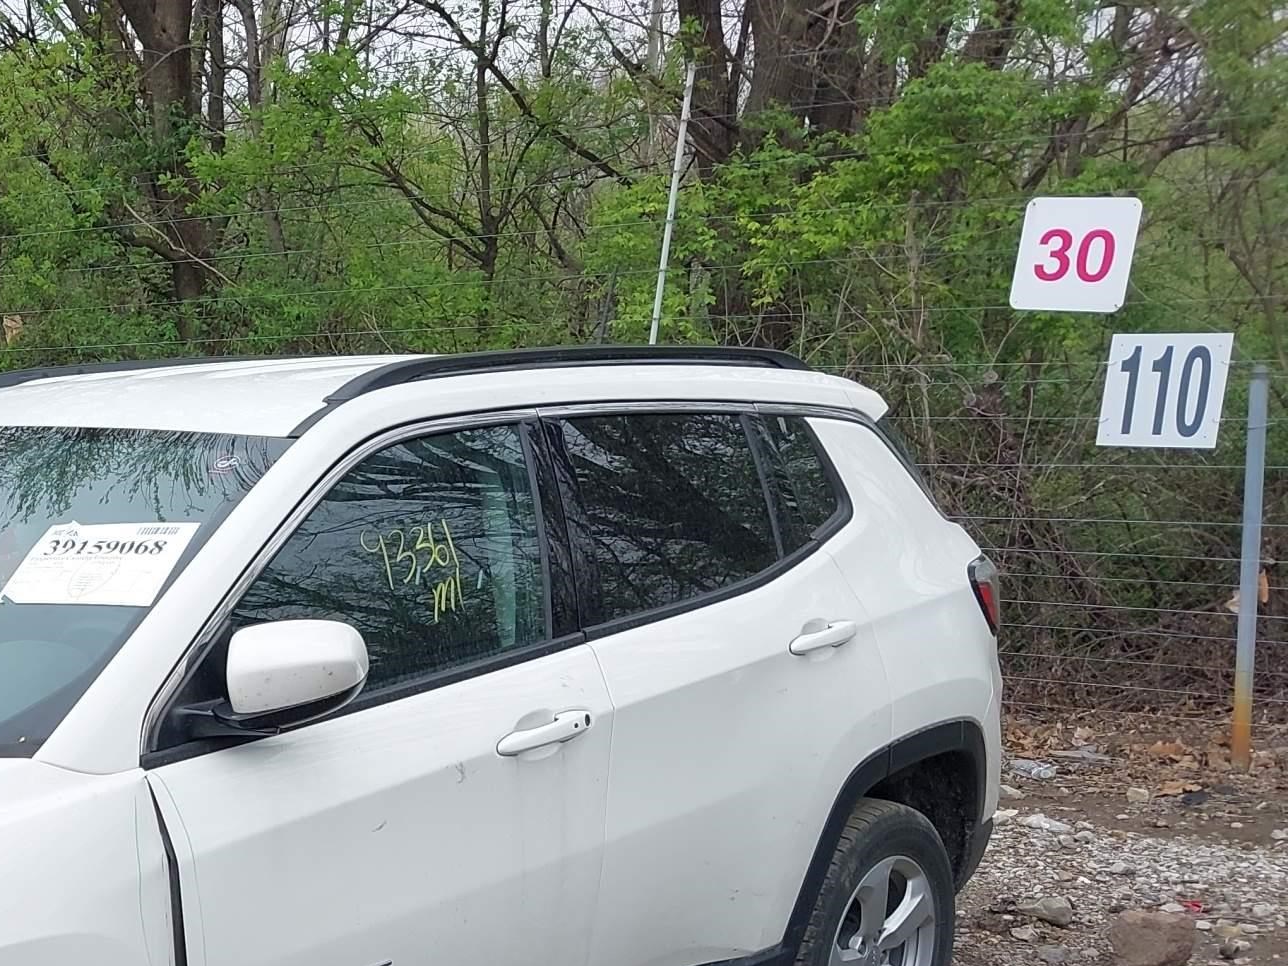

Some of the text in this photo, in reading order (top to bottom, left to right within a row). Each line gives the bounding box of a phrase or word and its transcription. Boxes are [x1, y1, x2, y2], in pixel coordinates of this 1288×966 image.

[1033, 228, 1116, 283] 30
[1120, 345, 1212, 438] 110
[43, 539, 168, 556] 39159068
